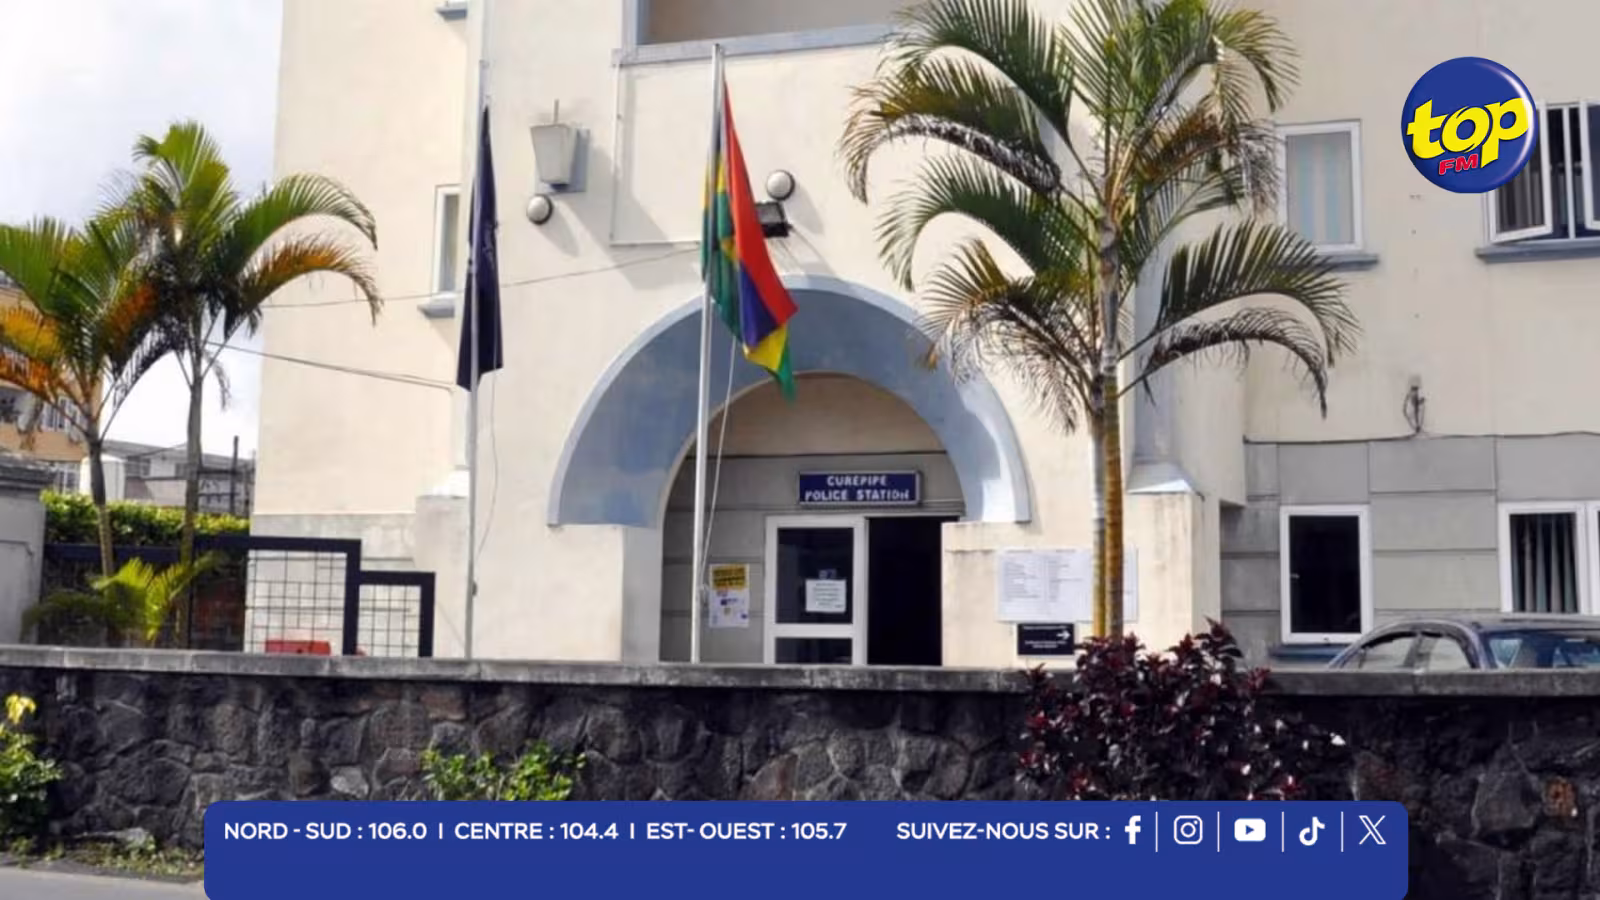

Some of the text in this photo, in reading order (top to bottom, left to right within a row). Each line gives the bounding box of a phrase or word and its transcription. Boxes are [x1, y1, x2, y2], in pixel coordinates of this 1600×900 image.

[826, 475, 888, 487] CUREPIPE
[804, 489, 910, 501] POLICE STATION
